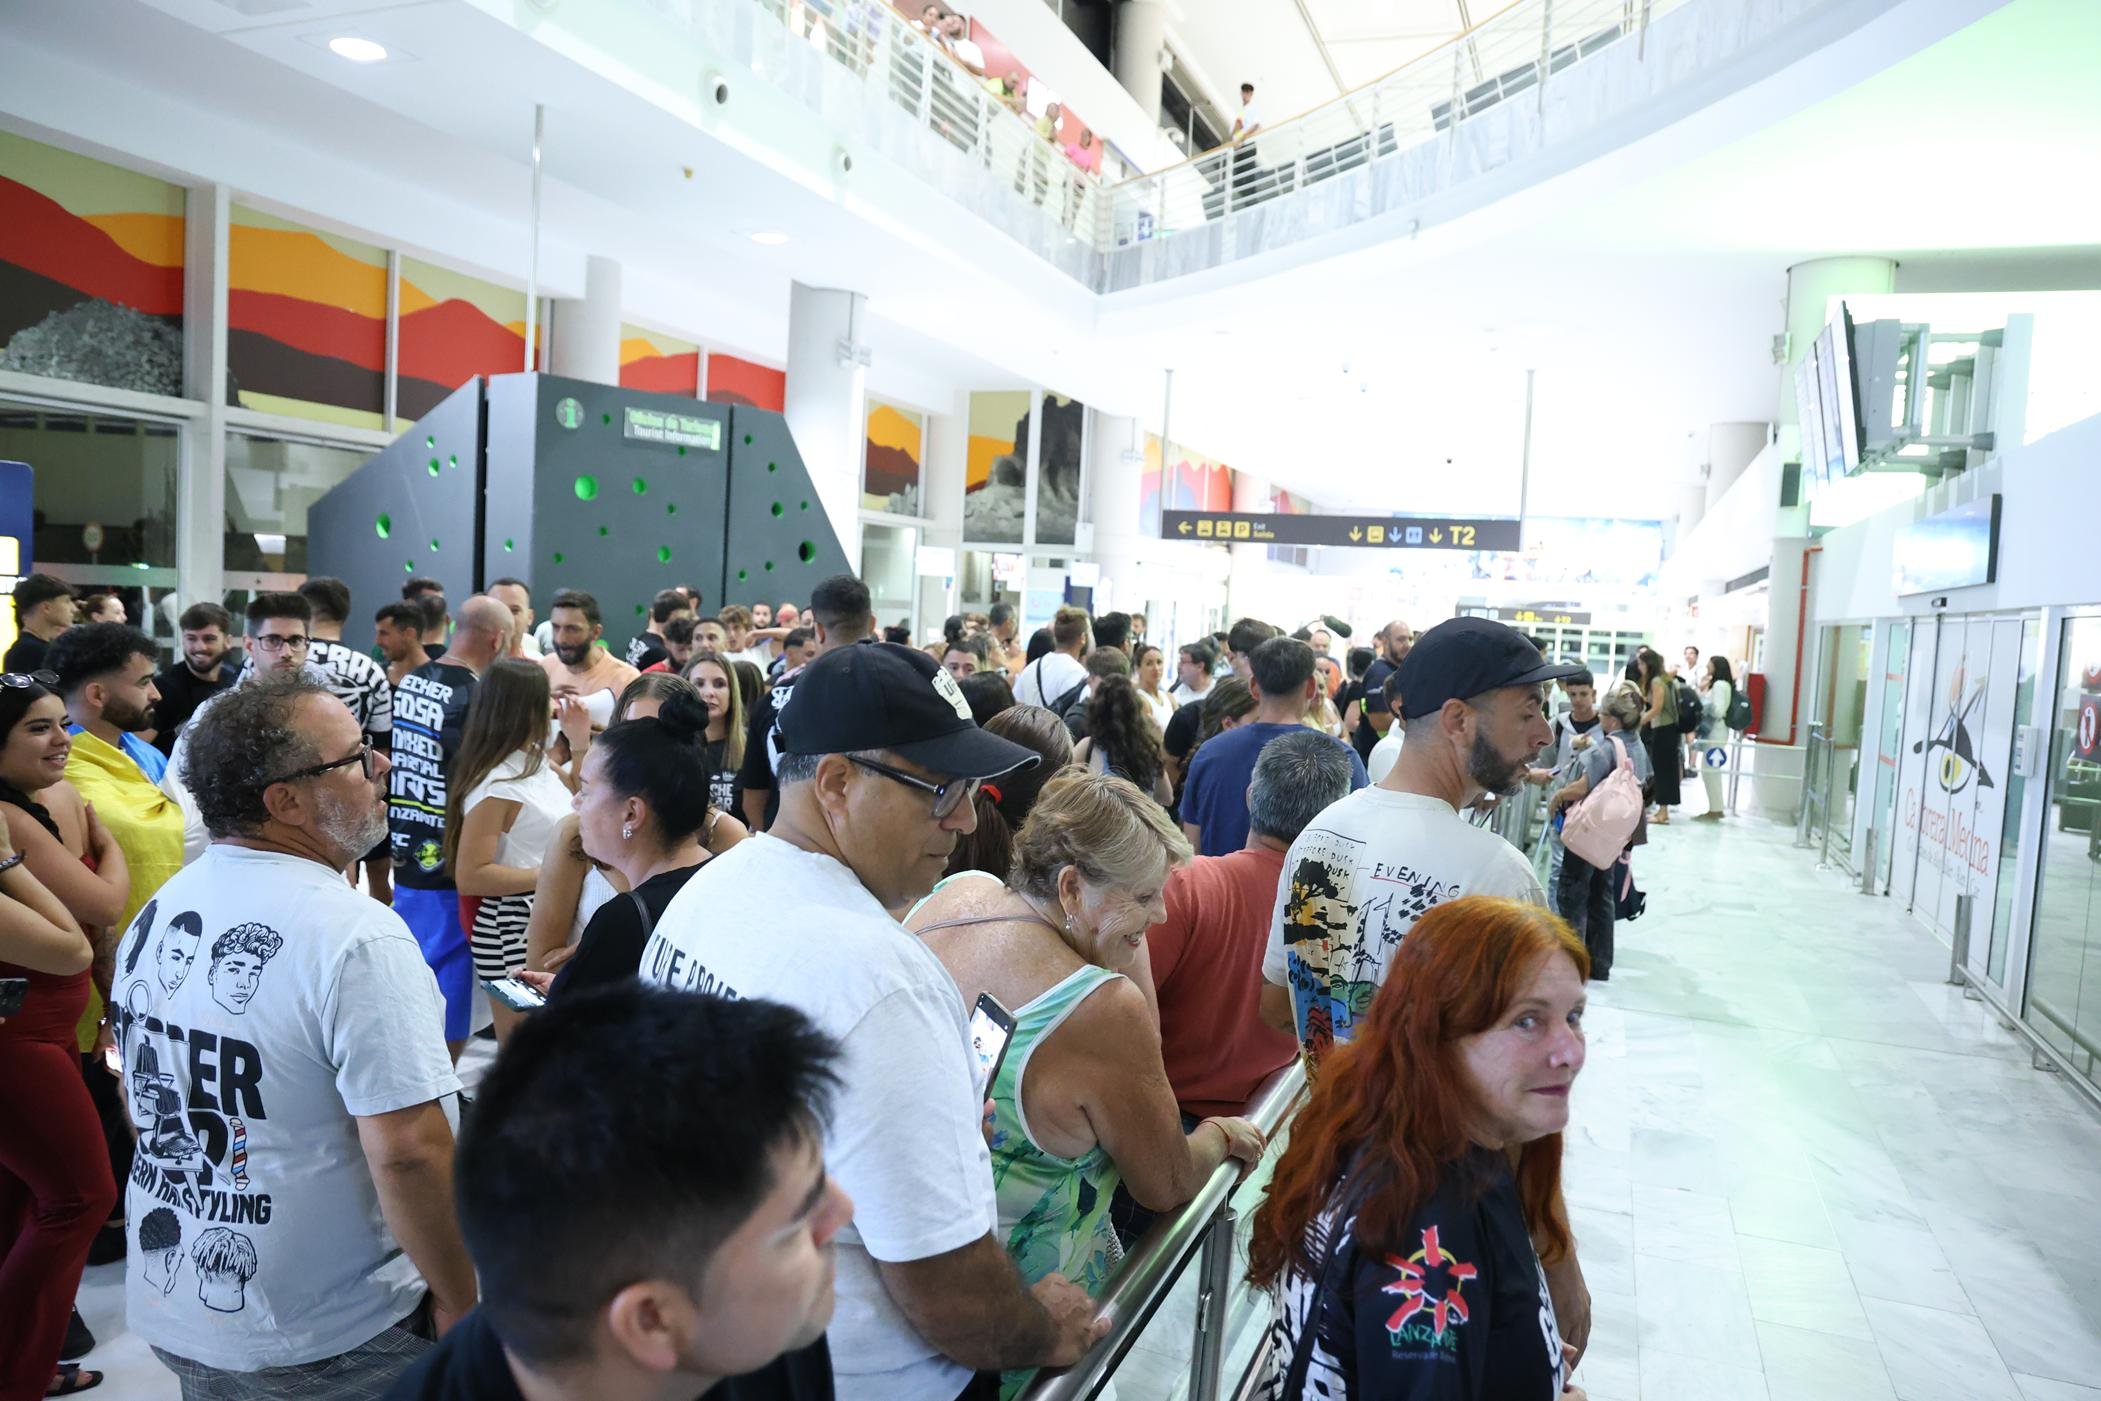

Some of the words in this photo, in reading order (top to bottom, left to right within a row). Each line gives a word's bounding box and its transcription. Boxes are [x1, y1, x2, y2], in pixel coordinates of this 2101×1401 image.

[1449, 526, 1476, 545] T2
[398, 674, 454, 704] ECHER
[1374, 862, 1460, 897] EVENING
